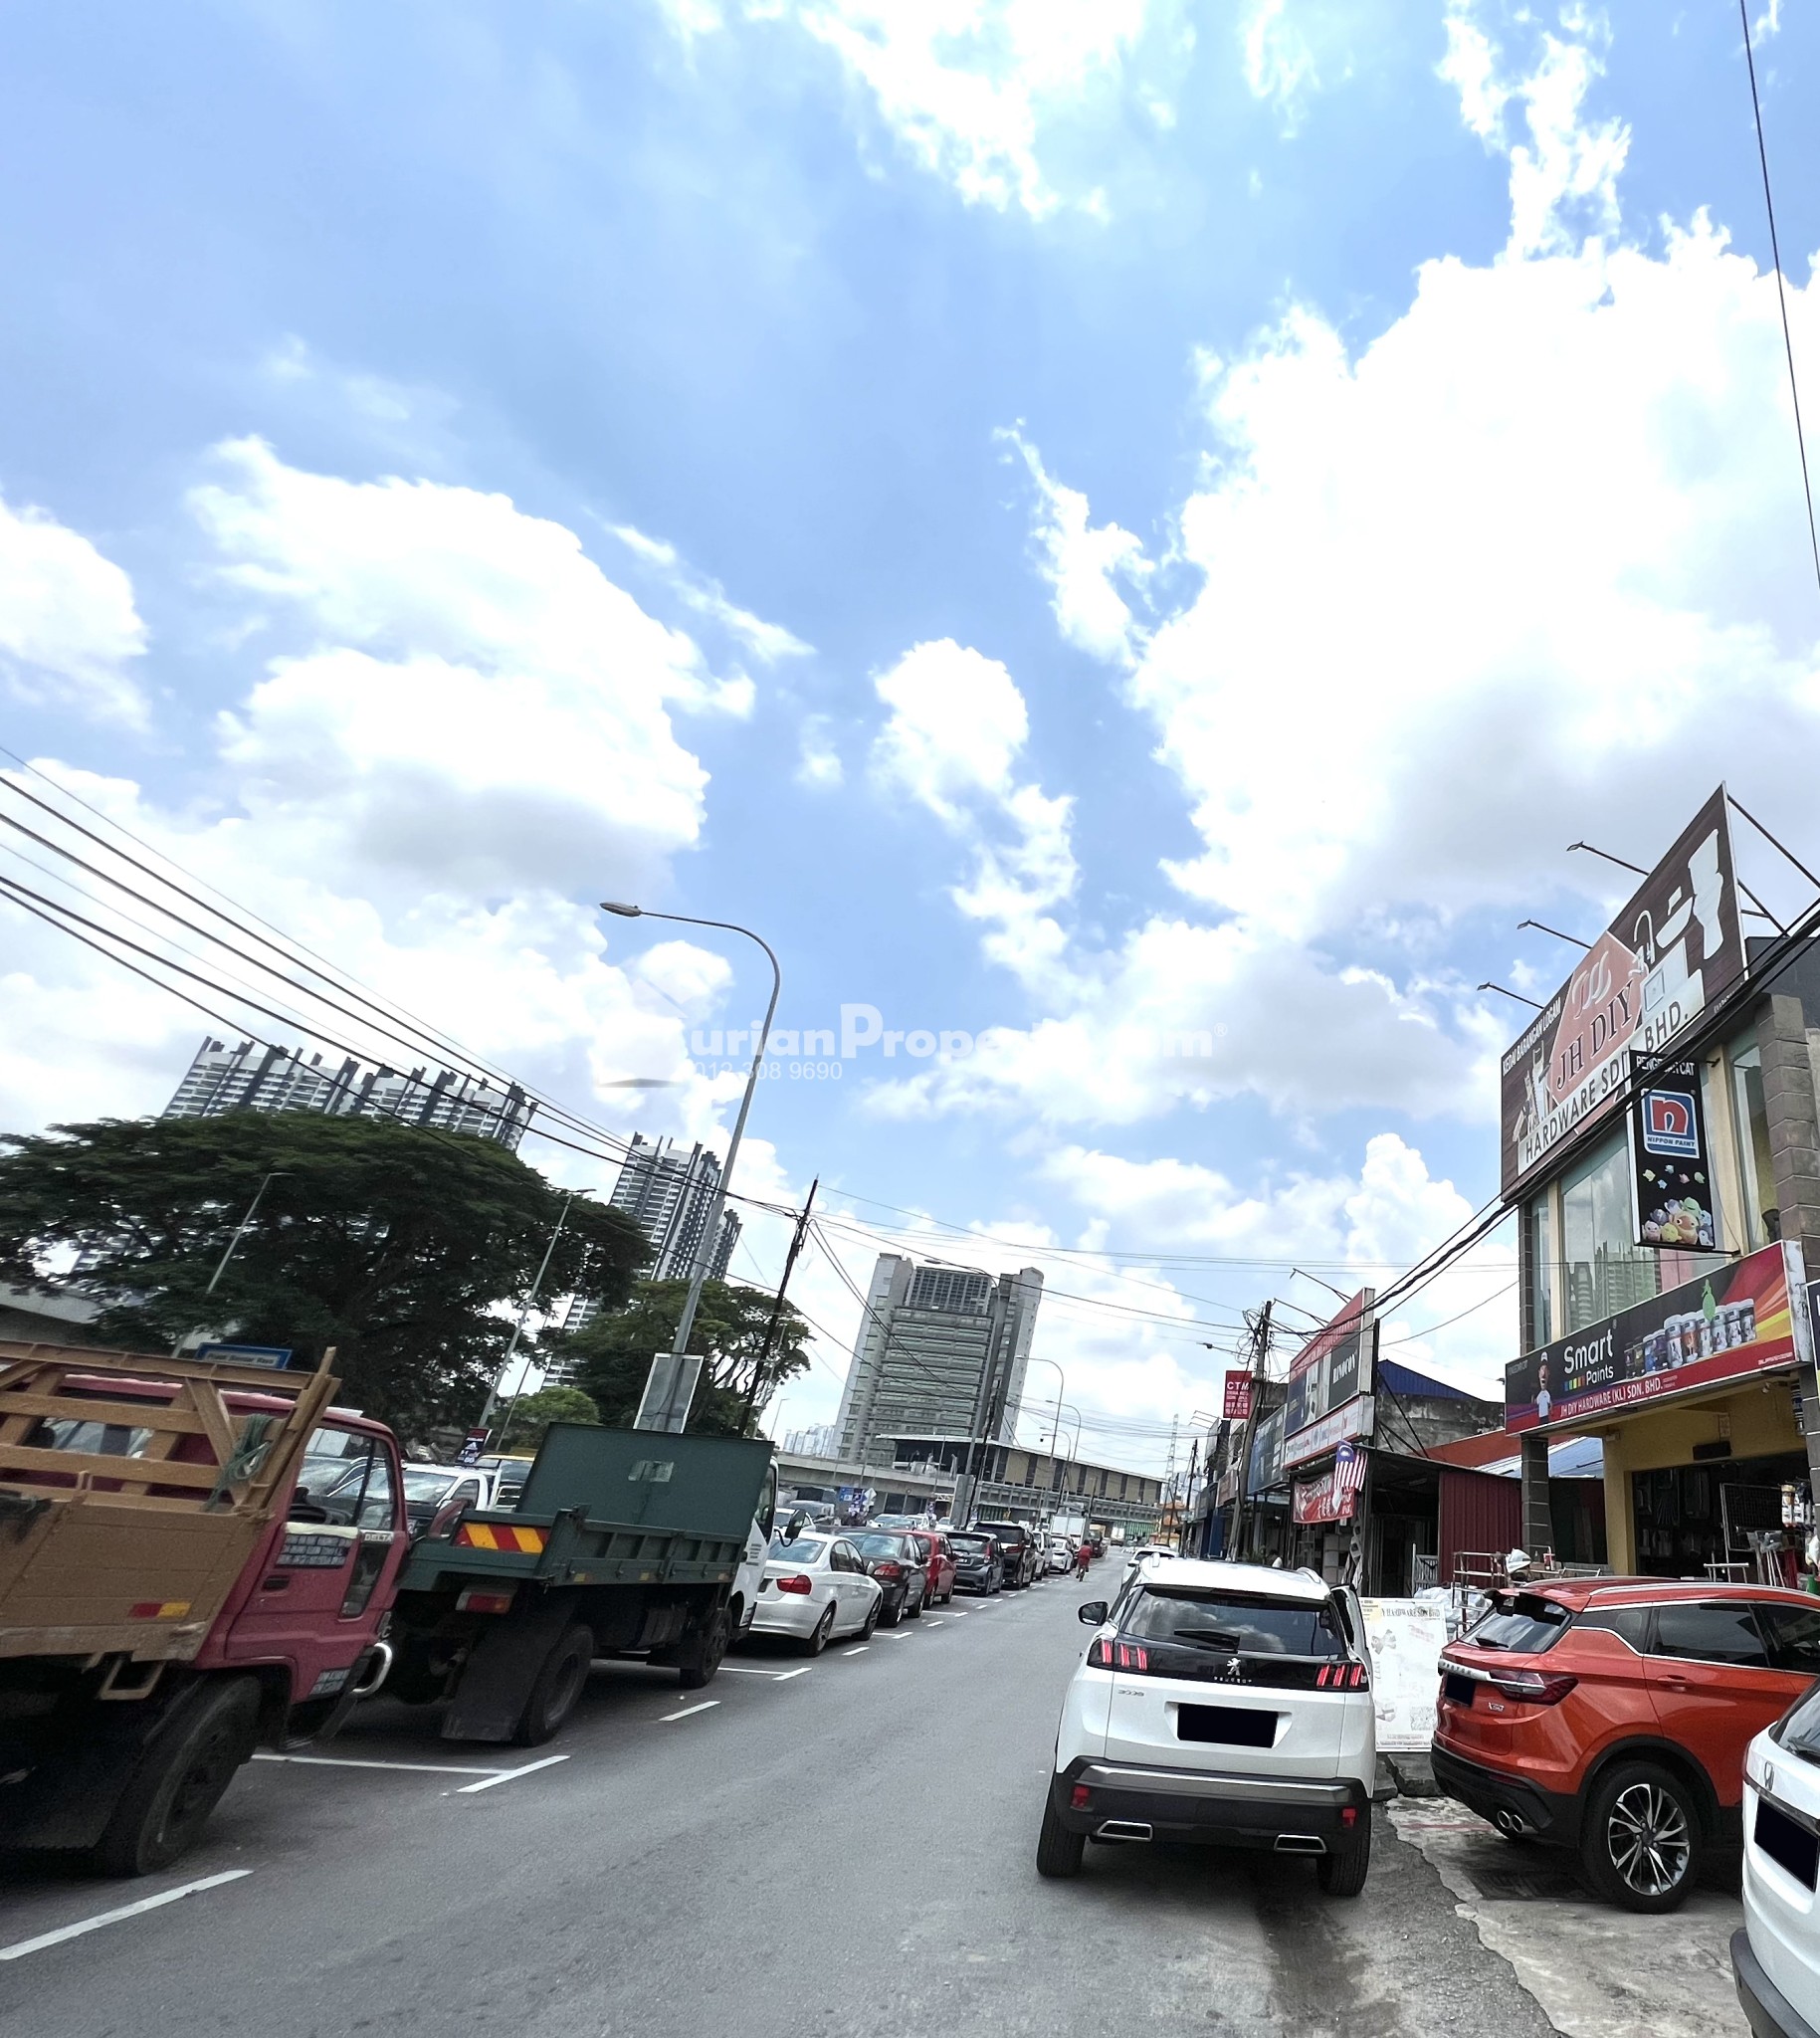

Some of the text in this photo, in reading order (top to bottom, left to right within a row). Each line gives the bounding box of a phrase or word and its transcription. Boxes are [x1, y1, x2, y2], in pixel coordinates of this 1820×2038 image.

[1557, 977, 1634, 1092] JH DIY
[1679, 1062, 1696, 1076] CAT
[1525, 1078, 1597, 1164] HARDWARE
[1647, 1135, 1696, 1148] NIPPON PAINT
[1563, 1328, 1614, 1374] Smart
[1586, 1364, 1614, 1386] Paints
[1559, 1405, 1567, 1418] JH
[1567, 1401, 1578, 1415] DIY
[1578, 1389, 1611, 1412] HARDWARE
[1612, 1386, 1626, 1403] (KL)
[1627, 1383, 1645, 1399] SDN.
[1645, 1377, 1664, 1396] BHD.
[363, 1532, 393, 1542] DELTA
